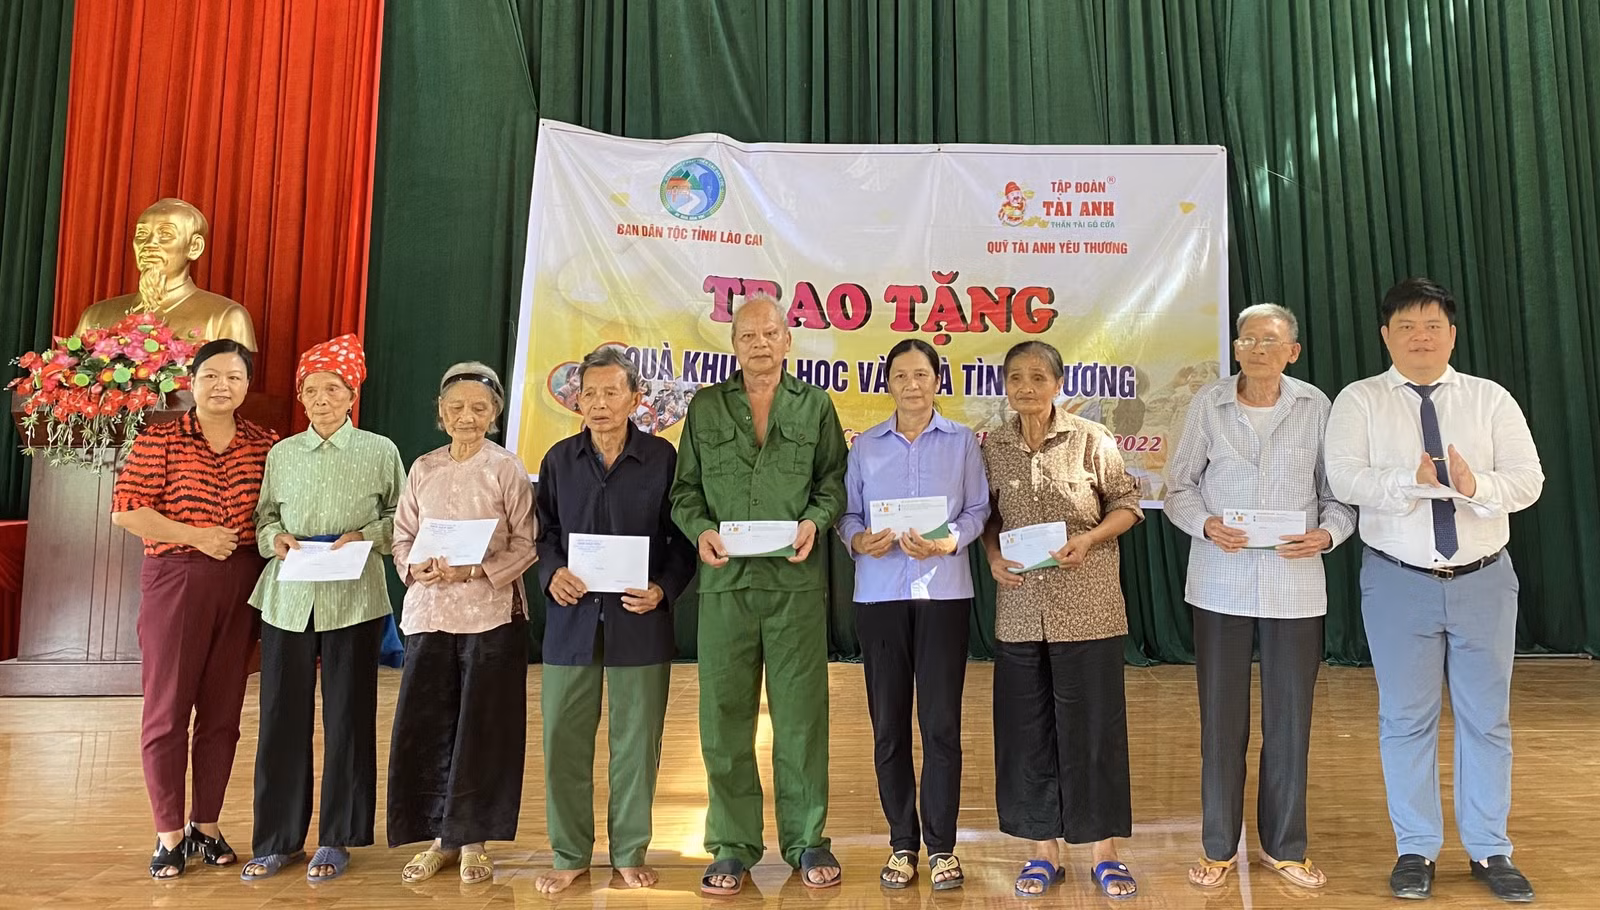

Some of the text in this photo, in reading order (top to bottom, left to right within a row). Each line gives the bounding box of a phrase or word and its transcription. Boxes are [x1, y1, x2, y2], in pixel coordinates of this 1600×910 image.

[1043, 197, 1115, 217] TÀI ANH
[616, 223, 640, 236] BAN
[641, 223, 664, 238] DÂN
[666, 225, 688, 242] TỘC
[744, 233, 763, 246] CAI
[1012, 239, 1029, 254] TÀI
[1032, 242, 1056, 254] ANH
[1059, 239, 1080, 254] YÊU
[1083, 240, 1128, 255] THƯƠNG
[702, 270, 1060, 346] TAO TẶNG
[857, 355, 890, 395] VÀ
[961, 357, 1009, 397] TÌN
